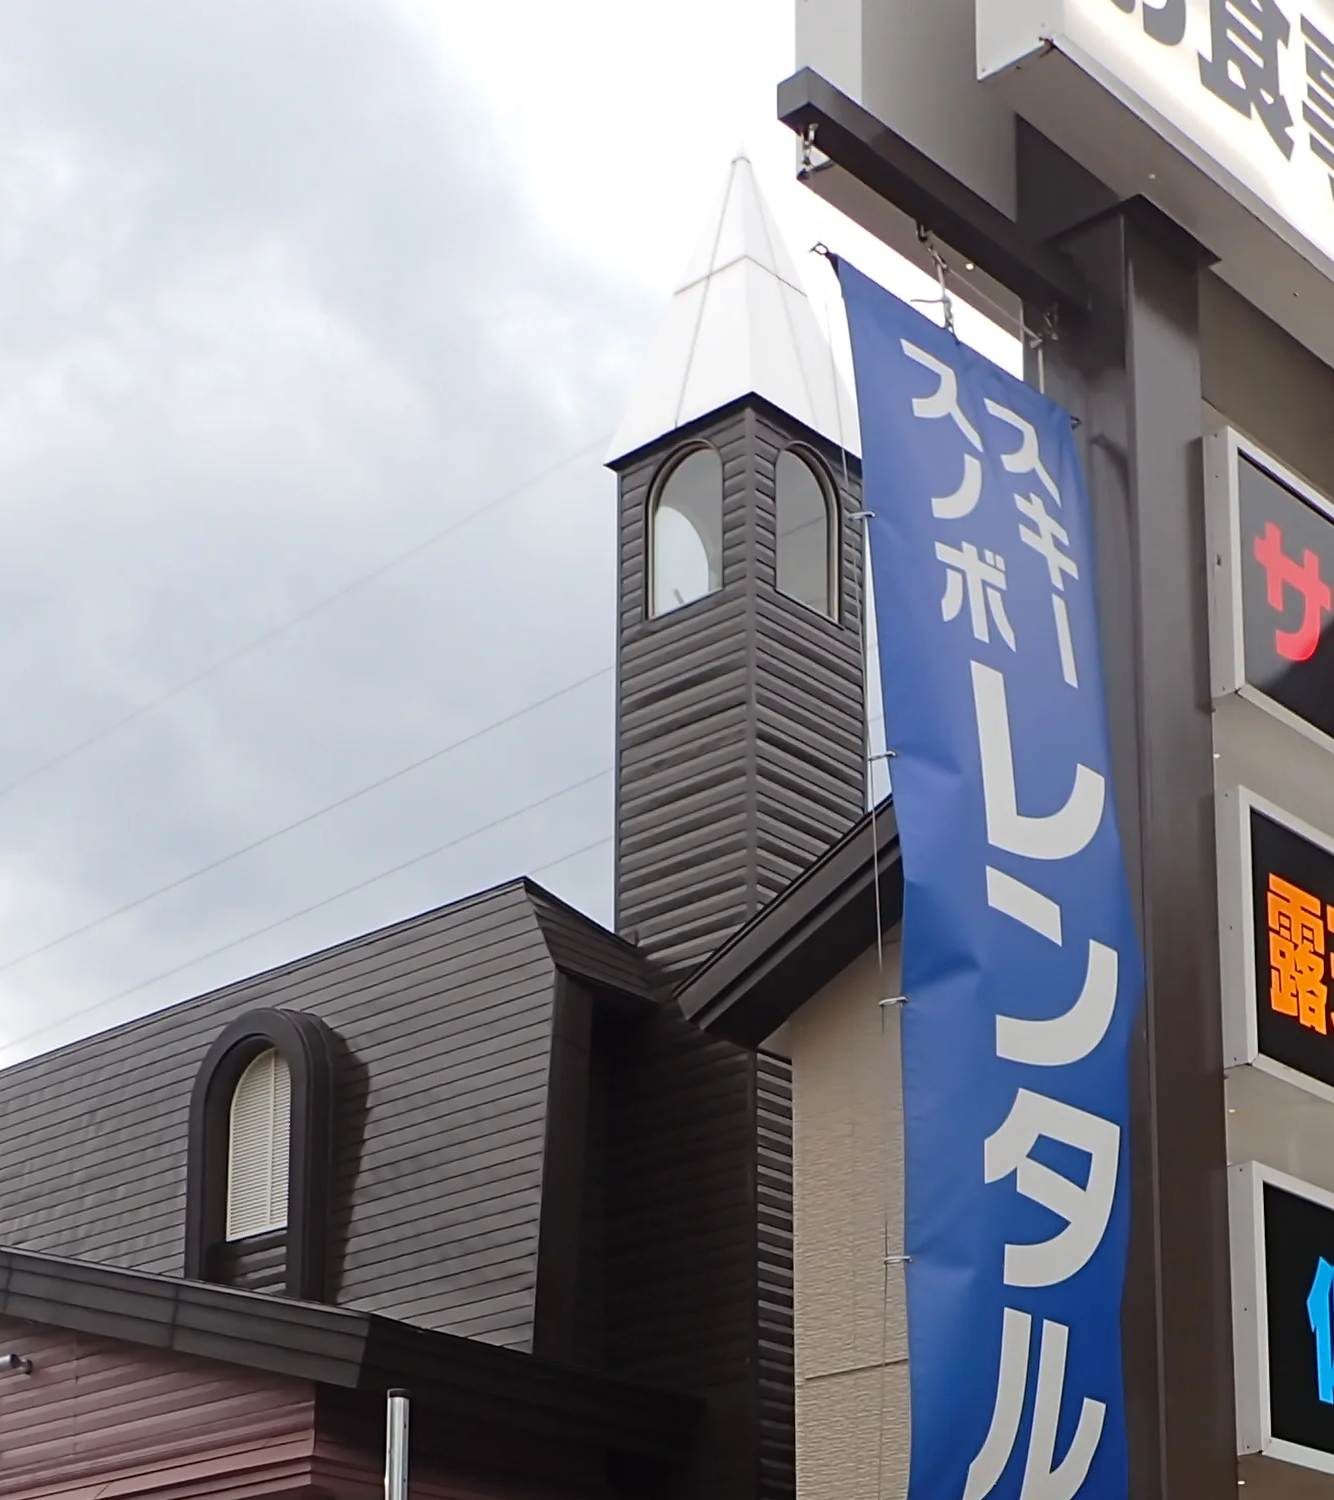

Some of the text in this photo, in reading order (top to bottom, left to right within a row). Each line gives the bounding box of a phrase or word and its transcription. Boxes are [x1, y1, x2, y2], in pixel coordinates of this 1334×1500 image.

[899, 337, 1017, 653] スノボ
[984, 397, 1080, 689] スキー
